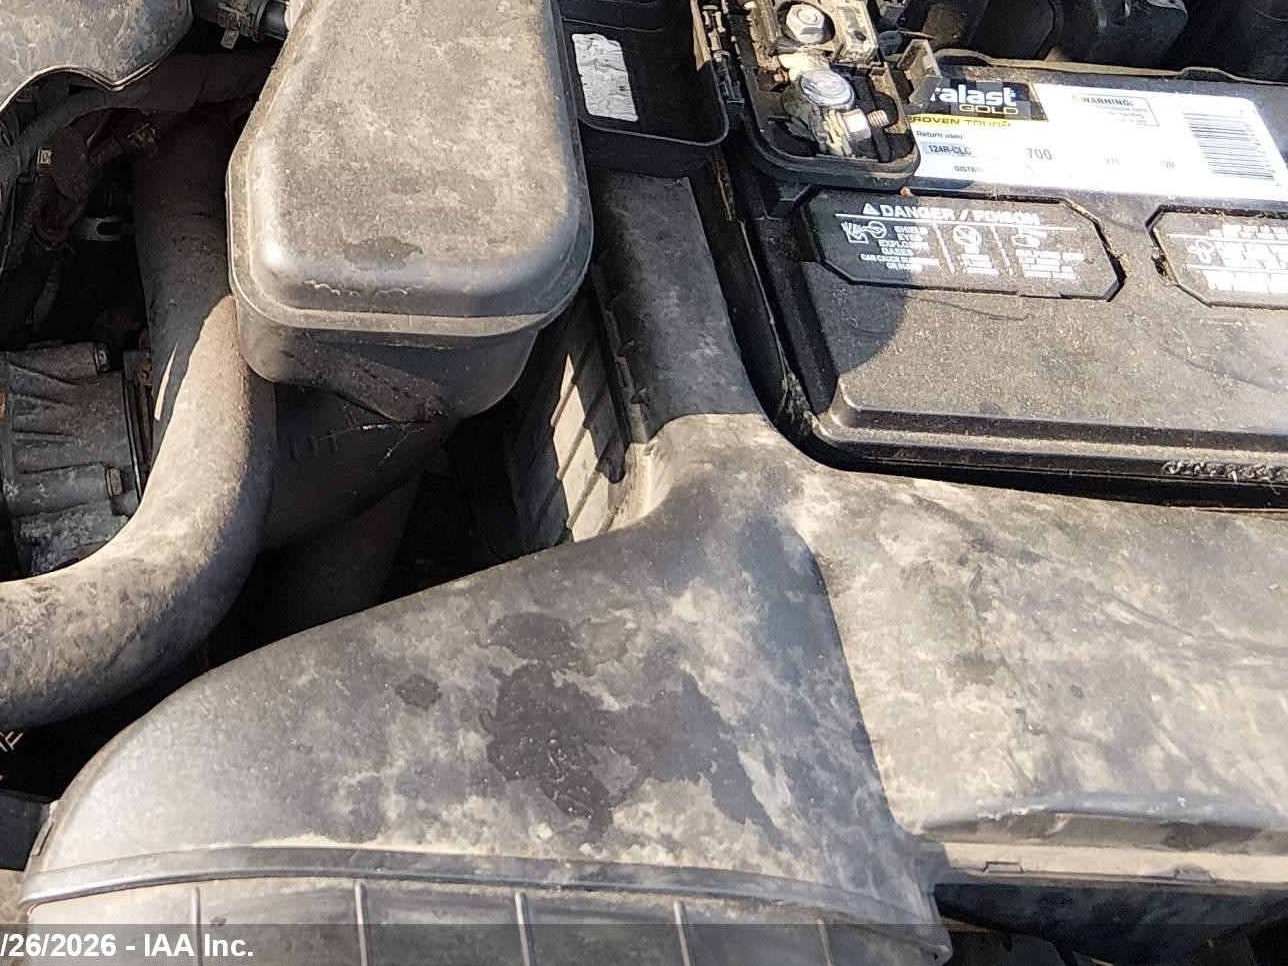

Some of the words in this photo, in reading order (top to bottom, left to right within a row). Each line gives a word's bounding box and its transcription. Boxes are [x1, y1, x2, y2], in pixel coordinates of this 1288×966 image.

[958, 103, 1019, 115] GOLD
[906, 115, 960, 125] PROVEN
[916, 130, 943, 139] Return
[1026, 147, 1053, 161] 700
[880, 204, 955, 221] DANGER
[972, 209, 1041, 226] POISON
[893, 225, 929, 235] SHIELD
